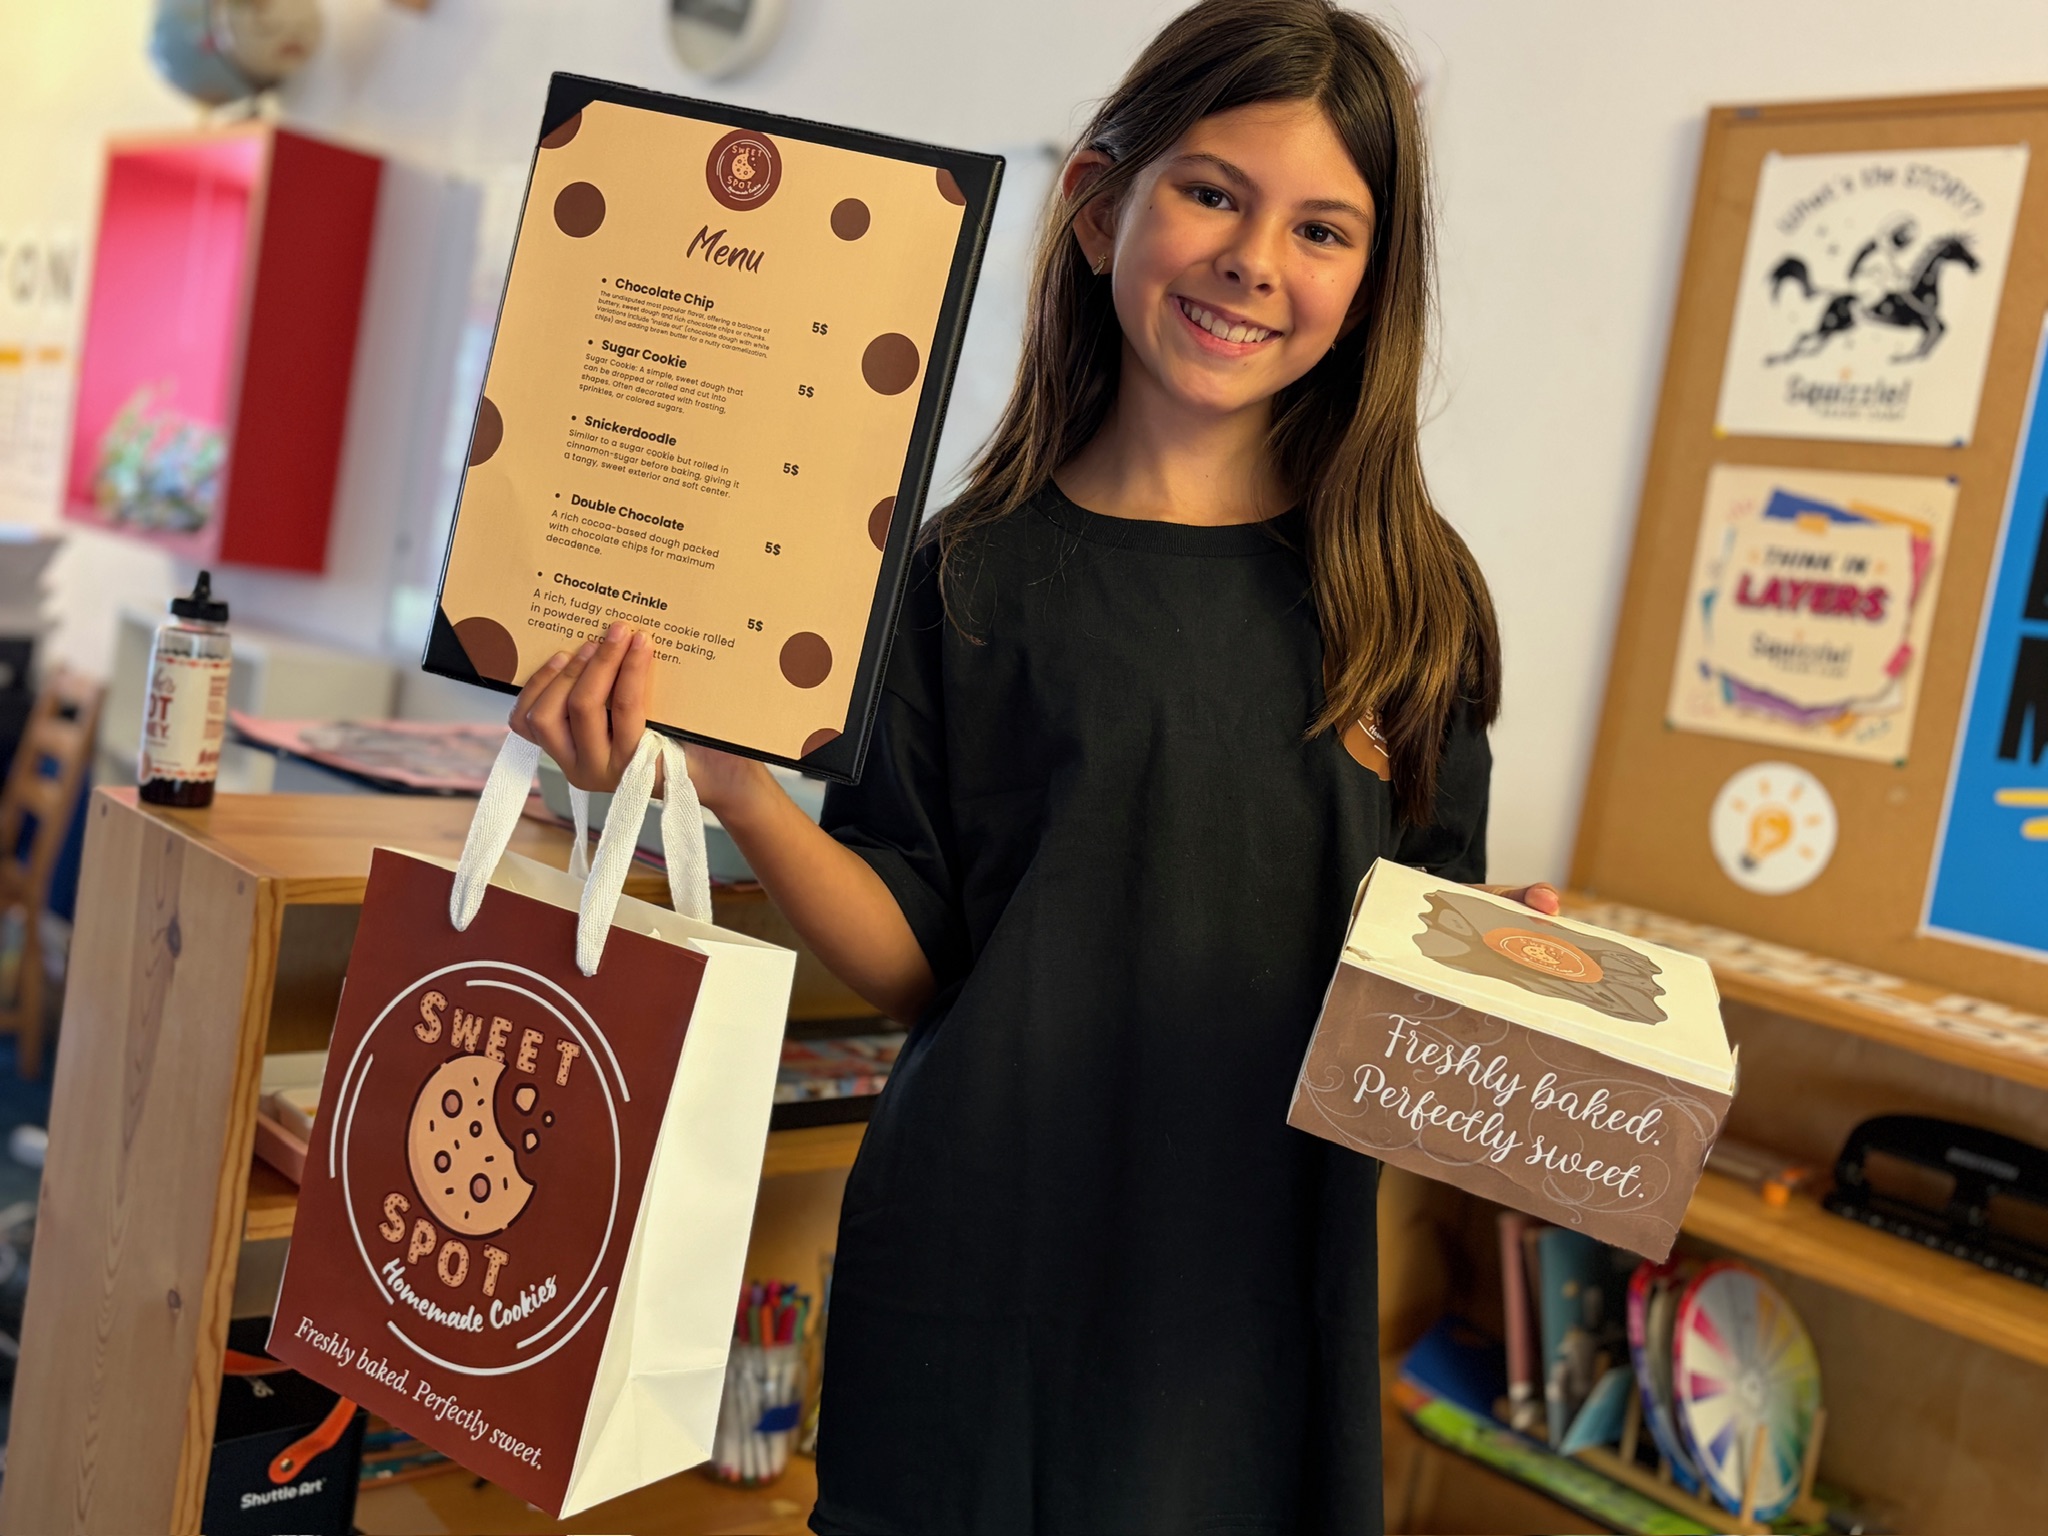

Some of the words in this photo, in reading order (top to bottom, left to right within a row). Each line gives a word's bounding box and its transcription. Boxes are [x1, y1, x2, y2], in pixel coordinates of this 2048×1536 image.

[727, 176, 752, 189] SPOT
[687, 225, 765, 274] Menu
[600, 290, 611, 298] The
[611, 293, 646, 305] undisputed
[645, 301, 662, 309] most
[661, 304, 686, 314] popular
[706, 314, 731, 326] offering
[736, 321, 762, 332] balance
[615, 278, 682, 301] Chocolate
[683, 293, 714, 312] Chip
[594, 313, 614, 324] chips)
[627, 321, 649, 333] adding
[649, 326, 669, 335] brown
[669, 330, 688, 339] butter
[704, 339, 721, 349] nutty
[596, 305, 627, 317] Variations
[626, 311, 650, 323] include
[684, 324, 717, 338] (chocolate
[718, 334, 738, 344] dough
[753, 342, 770, 351] white
[597, 297, 621, 308] buttery,
[621, 303, 640, 312] sweet
[640, 307, 660, 317] dough
[660, 312, 674, 320] and
[673, 314, 686, 323] rich
[686, 319, 717, 330] chocolate
[717, 326, 735, 334] chips
[812, 322, 828, 335] 5$
[601, 339, 641, 358] Sugar
[641, 349, 687, 369] Cookie
[581, 373, 610, 386] shapes.
[612, 380, 633, 391] Often
[634, 386, 676, 401] decorated
[676, 396, 693, 405] with
[694, 399, 726, 415] frosting,
[583, 364, 598, 372] can
[599, 366, 610, 375] be
[611, 370, 645, 383] dropped
[655, 381, 679, 391] rolled
[679, 386, 696, 395] and
[696, 390, 710, 399] cut
[711, 392, 727, 403] into
[585, 353, 608, 365] Sugar
[609, 358, 638, 371] Cookie:
[646, 368, 674, 381] simple,
[675, 375, 699, 386] sweet
[699, 380, 725, 393] dough
[726, 386, 744, 396] that
[798, 385, 814, 398] 5$
[578, 383, 614, 398] sprinkles,
[625, 394, 655, 407] colored
[656, 402, 684, 414] sugars.
[584, 415, 677, 446] Snickerdoodle
[566, 440, 639, 464] cinnamon-sugar
[640, 458, 669, 472] before
[670, 465, 702, 481] baking,
[703, 474, 732, 489] giving
[733, 479, 740, 489] it
[568, 428, 599, 442] Similar
[600, 436, 610, 445] to
[619, 442, 645, 453] sugar
[645, 448, 675, 461] cookie
[676, 453, 692, 466] but
[693, 460, 719, 472] rolled
[720, 464, 729, 474] in
[783, 463, 799, 476] 5$
[563, 451, 570, 459] a
[571, 452, 598, 468] tangy,
[600, 461, 626, 473] sweet
[627, 468, 661, 481] exterior
[662, 476, 681, 486] and
[681, 480, 699, 491] soft
[700, 485, 730, 498] center.
[570, 493, 616, 514] Double
[618, 506, 684, 531] Chocolate
[545, 533, 602, 555] decadence.
[549, 522, 569, 533] with
[570, 527, 620, 545] chocolate
[621, 540, 648, 553] chips
[650, 545, 664, 557] for
[665, 552, 715, 570] maximum
[551, 509, 558, 518] A
[560, 511, 579, 523] rich
[580, 517, 648, 540] cocoa-based
[648, 533, 680, 549] dough
[681, 542, 720, 558] packed
[765, 542, 781, 555] 5$
[553, 572, 620, 599] Chocolate
[621, 589, 668, 611] Crinkle
[1736, 572, 1889, 621] LAYERS
[527, 617, 574, 639] creating
[576, 630, 584, 638] a
[530, 601, 541, 613] in
[542, 607, 600, 628] powdered
[533, 588, 541, 598] A
[543, 590, 567, 606] rich,
[569, 597, 603, 616] fudgy
[604, 607, 661, 628] chocolate
[663, 622, 700, 638] cookie
[702, 632, 736, 648] rolled
[748, 619, 763, 632] 5$
[651, 632, 673, 647] fore
[675, 639, 716, 661] baking,
[653, 649, 681, 664] ttern.
[414, 990, 581, 1086] SWEET
[1385, 1015, 1525, 1107] Freshly
[1531, 1073, 1662, 1146] baked.
[1354, 1064, 1523, 1162] Perfectly
[1525, 1136, 1644, 1199] sweet.
[379, 1192, 510, 1297] SPOT
[382, 1257, 484, 1332] Homemade
[489, 1274, 557, 1329] Cookies
[294, 1316, 355, 1367] Freshly
[356, 1348, 408, 1395] baked.
[412, 1380, 490, 1441] Perfectly
[489, 1427, 542, 1470] sweet.
[241, 1485, 297, 1509] Shuttle
[299, 1479, 323, 1496] Art
